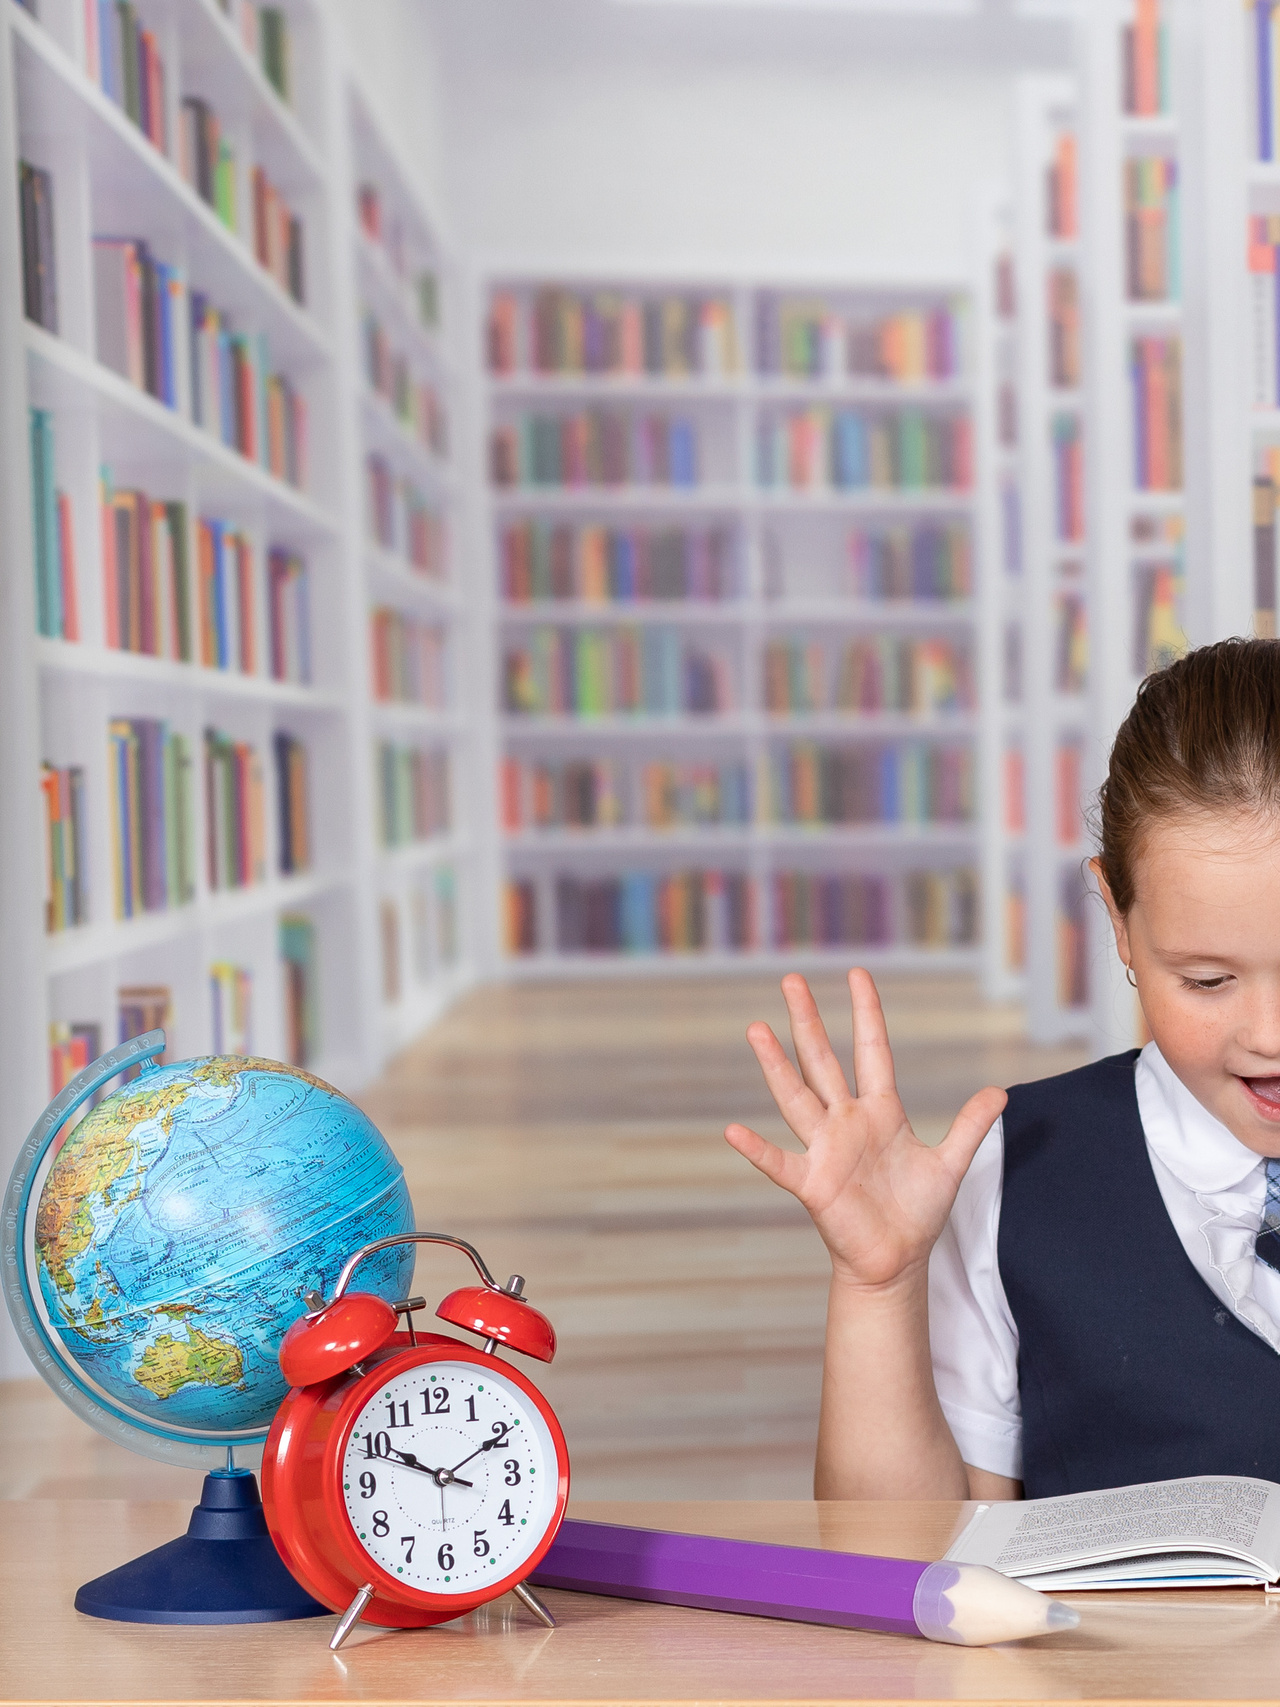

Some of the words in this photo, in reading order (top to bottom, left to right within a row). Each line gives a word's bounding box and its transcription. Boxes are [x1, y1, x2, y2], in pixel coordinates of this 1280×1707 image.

[385, 1399, 414, 1429] 11
[419, 1386, 451, 1415] 12
[464, 1394, 480, 1422] 1
[361, 1430, 392, 1460] 10
[491, 1421, 510, 1449] 2
[359, 1471, 377, 1499] 9
[504, 1459, 522, 1486] 3
[372, 1510, 390, 1538] 8
[497, 1499, 515, 1526] 4
[400, 1536, 416, 1564] 7
[437, 1543, 455, 1571] 6
[473, 1529, 491, 1557] 5
